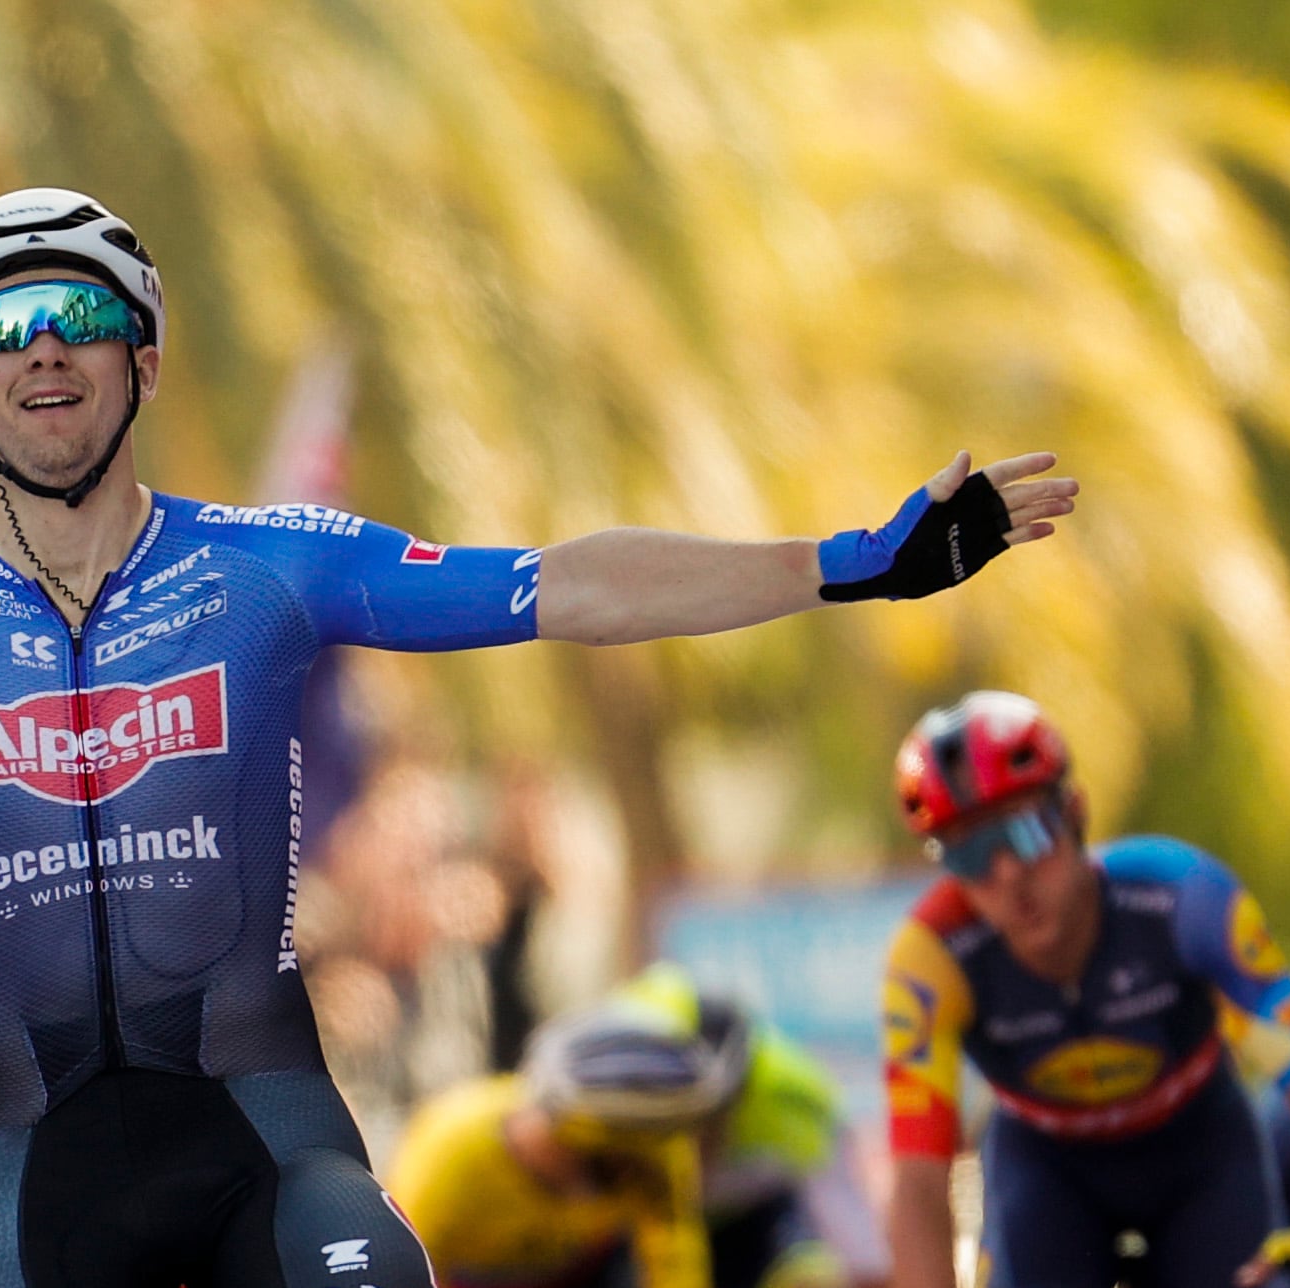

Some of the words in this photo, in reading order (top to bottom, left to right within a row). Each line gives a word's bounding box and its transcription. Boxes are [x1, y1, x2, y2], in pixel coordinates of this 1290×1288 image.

[139, 544, 212, 594] ZWIFT
[97, 572, 225, 631] CANYON
[61, 732, 197, 776] BOOSTER
[30, 874, 155, 908] WINDOWS
